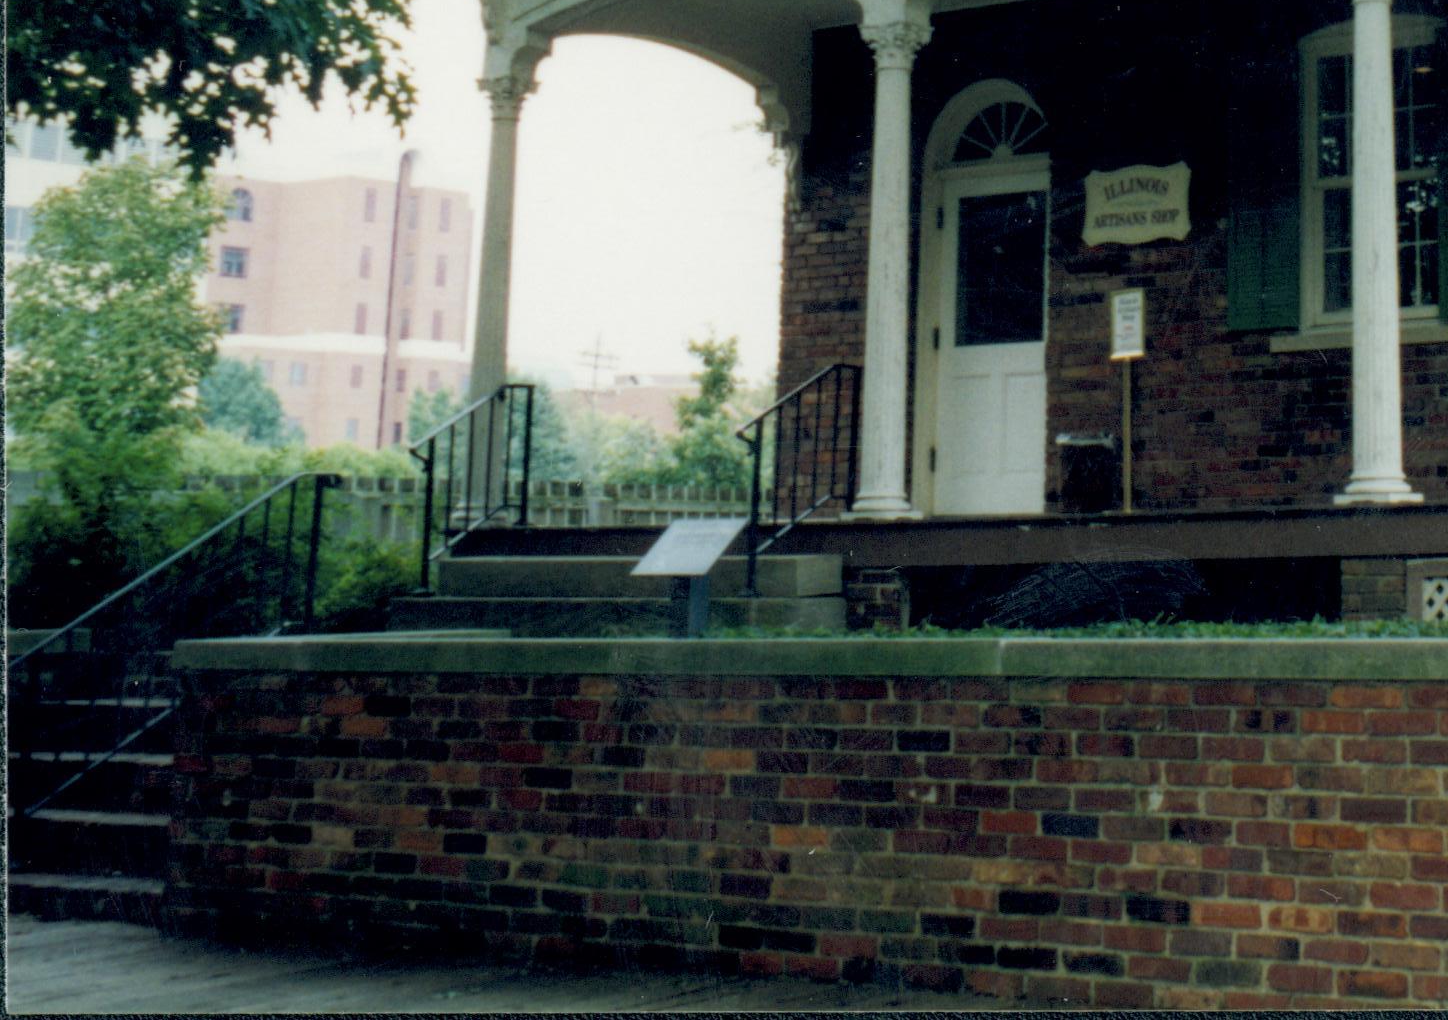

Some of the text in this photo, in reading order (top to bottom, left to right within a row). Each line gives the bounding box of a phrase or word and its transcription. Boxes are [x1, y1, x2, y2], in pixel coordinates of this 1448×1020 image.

[1104, 177, 1169, 201] ILLINOIS
[1094, 209, 1180, 229] ARTISANS SHOP
